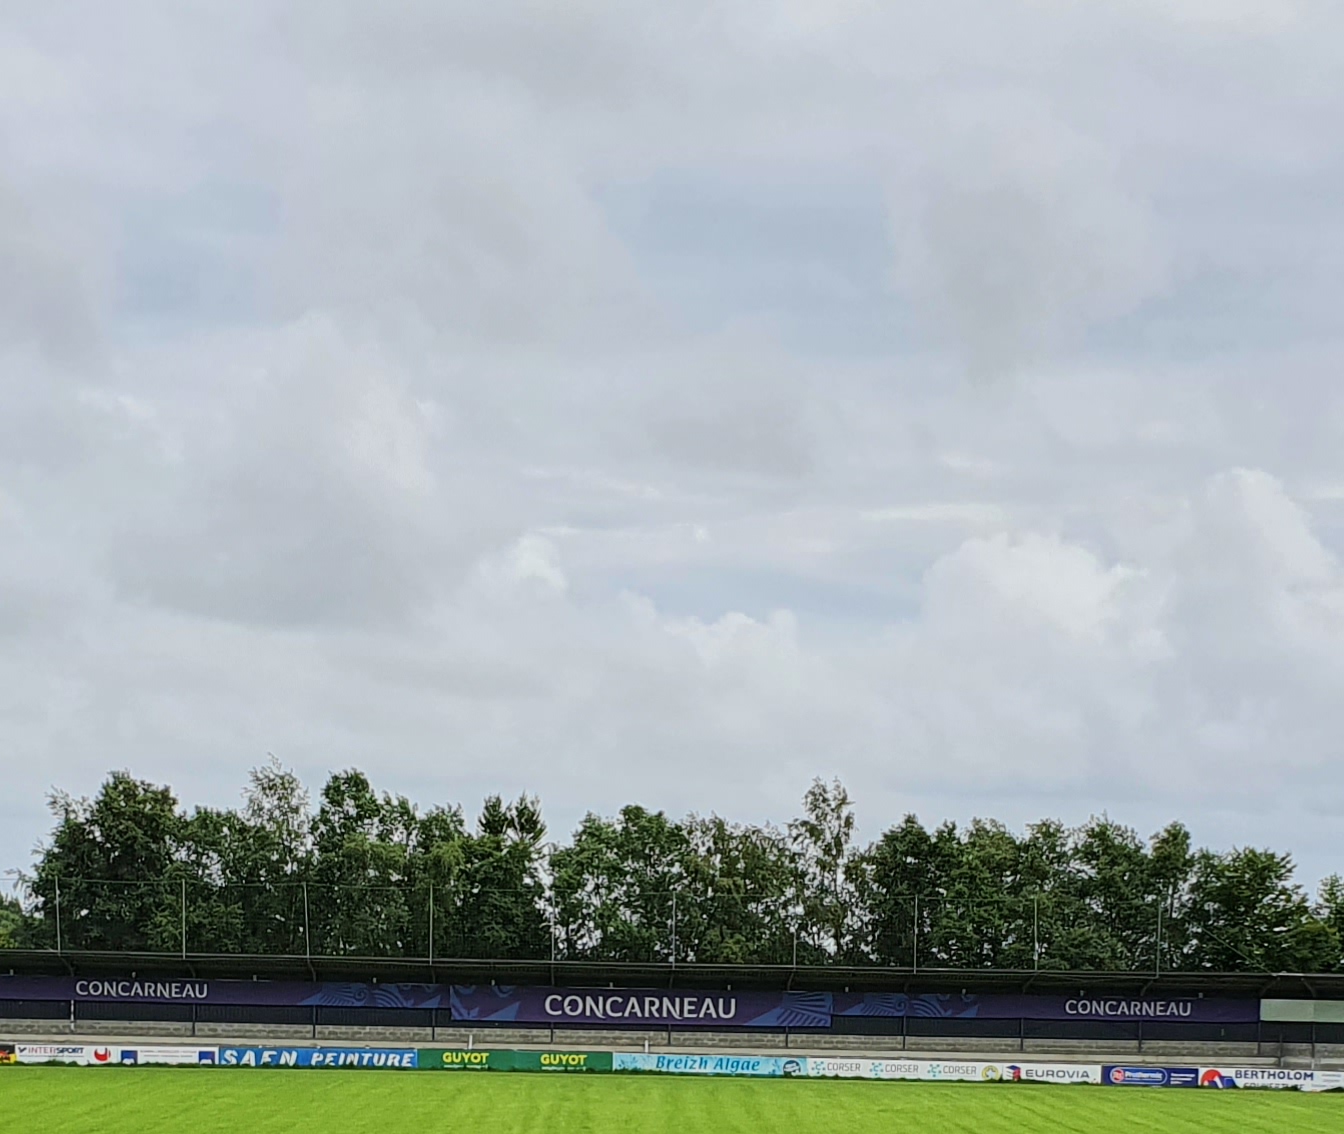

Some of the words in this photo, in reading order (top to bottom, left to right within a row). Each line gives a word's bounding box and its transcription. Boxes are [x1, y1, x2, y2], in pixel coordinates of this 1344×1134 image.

[75, 980, 208, 999] CONCARNEAU
[544, 994, 736, 1020] CONCARNEAU
[1065, 1000, 1192, 1017] CONCARNEAU
[28, 1046, 85, 1055] INTERSPORT
[310, 1052, 415, 1067] PEINTURE
[442, 1052, 490, 1064] GUYOT
[540, 1054, 588, 1065] GUYOT
[655, 1055, 708, 1070] Breizh
[713, 1057, 761, 1073] Algae
[827, 1062, 861, 1072] CORSER
[885, 1063, 919, 1073] CORSER
[942, 1064, 977, 1075] CORSER
[1025, 1069, 1090, 1079] EUROVIA
[1235, 1069, 1314, 1081] BERTHOLOM
